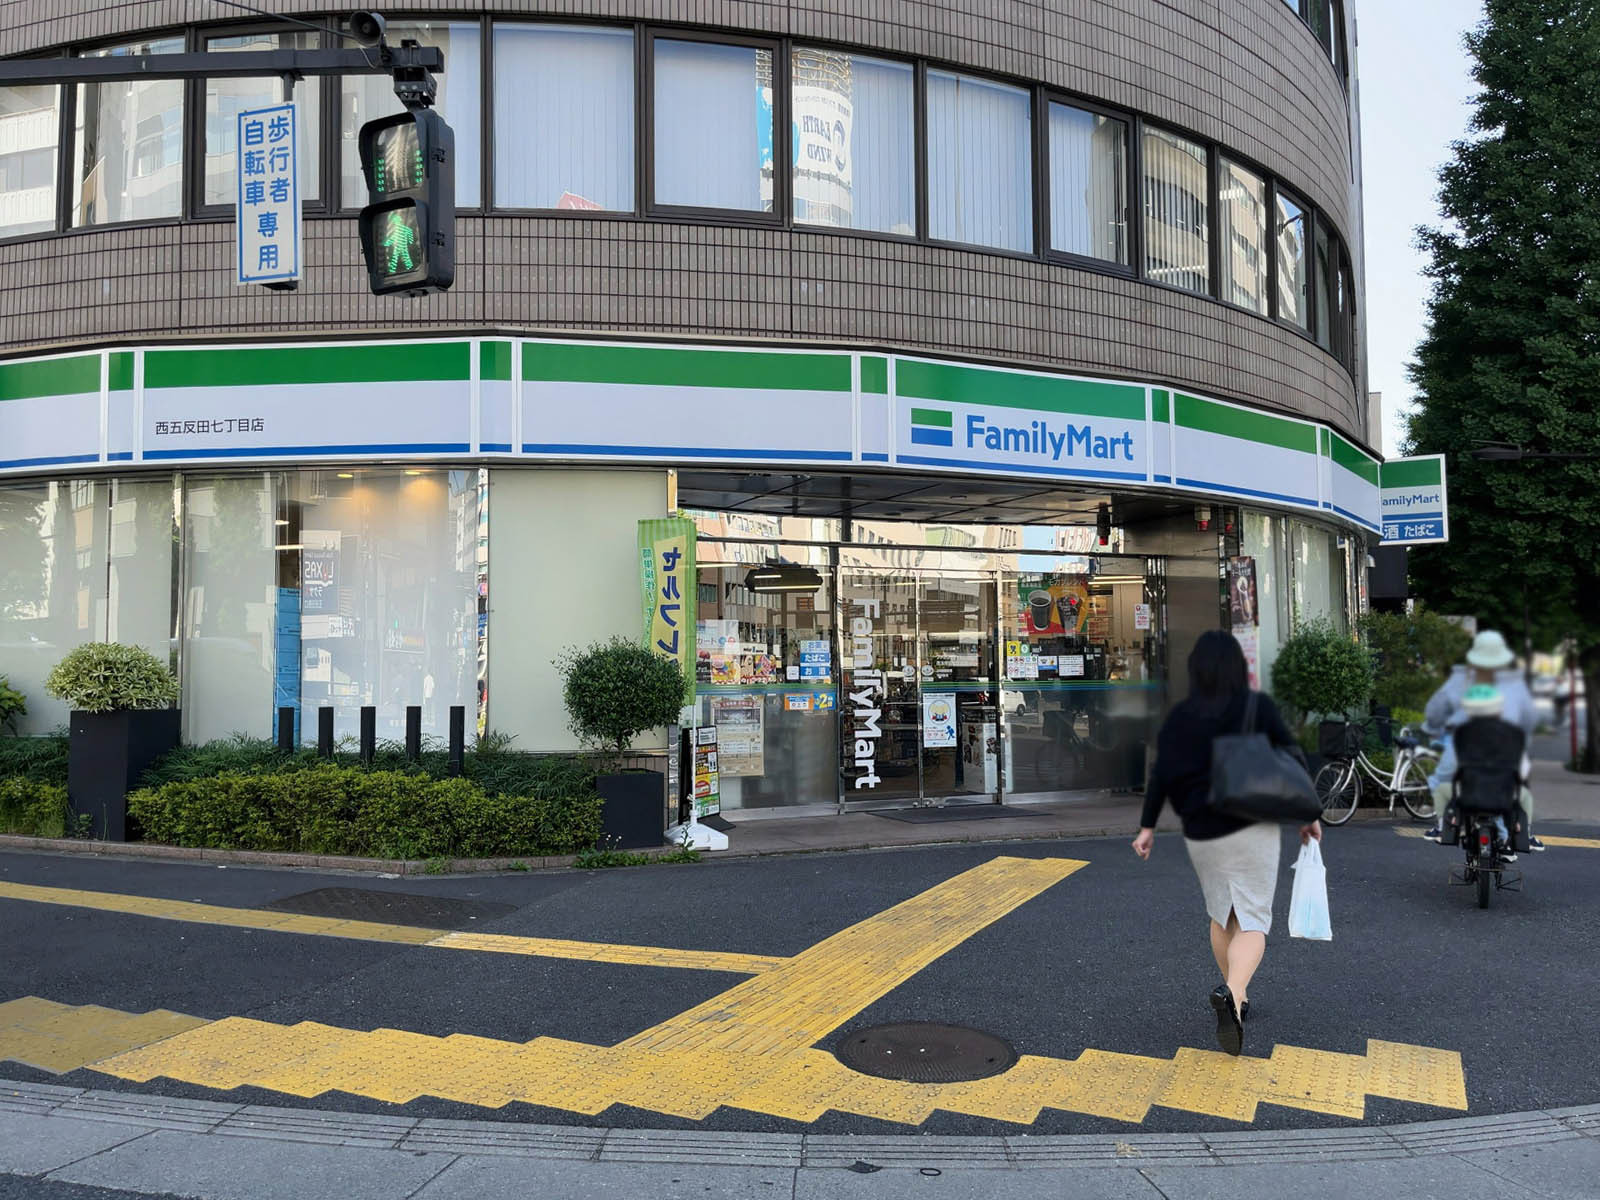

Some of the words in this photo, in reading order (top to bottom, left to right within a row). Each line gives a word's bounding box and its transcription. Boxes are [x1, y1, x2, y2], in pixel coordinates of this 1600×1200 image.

[244, 119, 266, 206] 自転車
[268, 115, 290, 203] 歩行者
[257, 211, 279, 271] 専用
[155, 417, 265, 435] 西五反田七丁目店
[966, 414, 1134, 461] FamilyMart
[1381, 493, 1440, 507] amilyMart
[1404, 523, 1436, 537] たばこ
[805, 654, 826, 663] たばこ
[850, 599, 883, 790] FamilyMart
